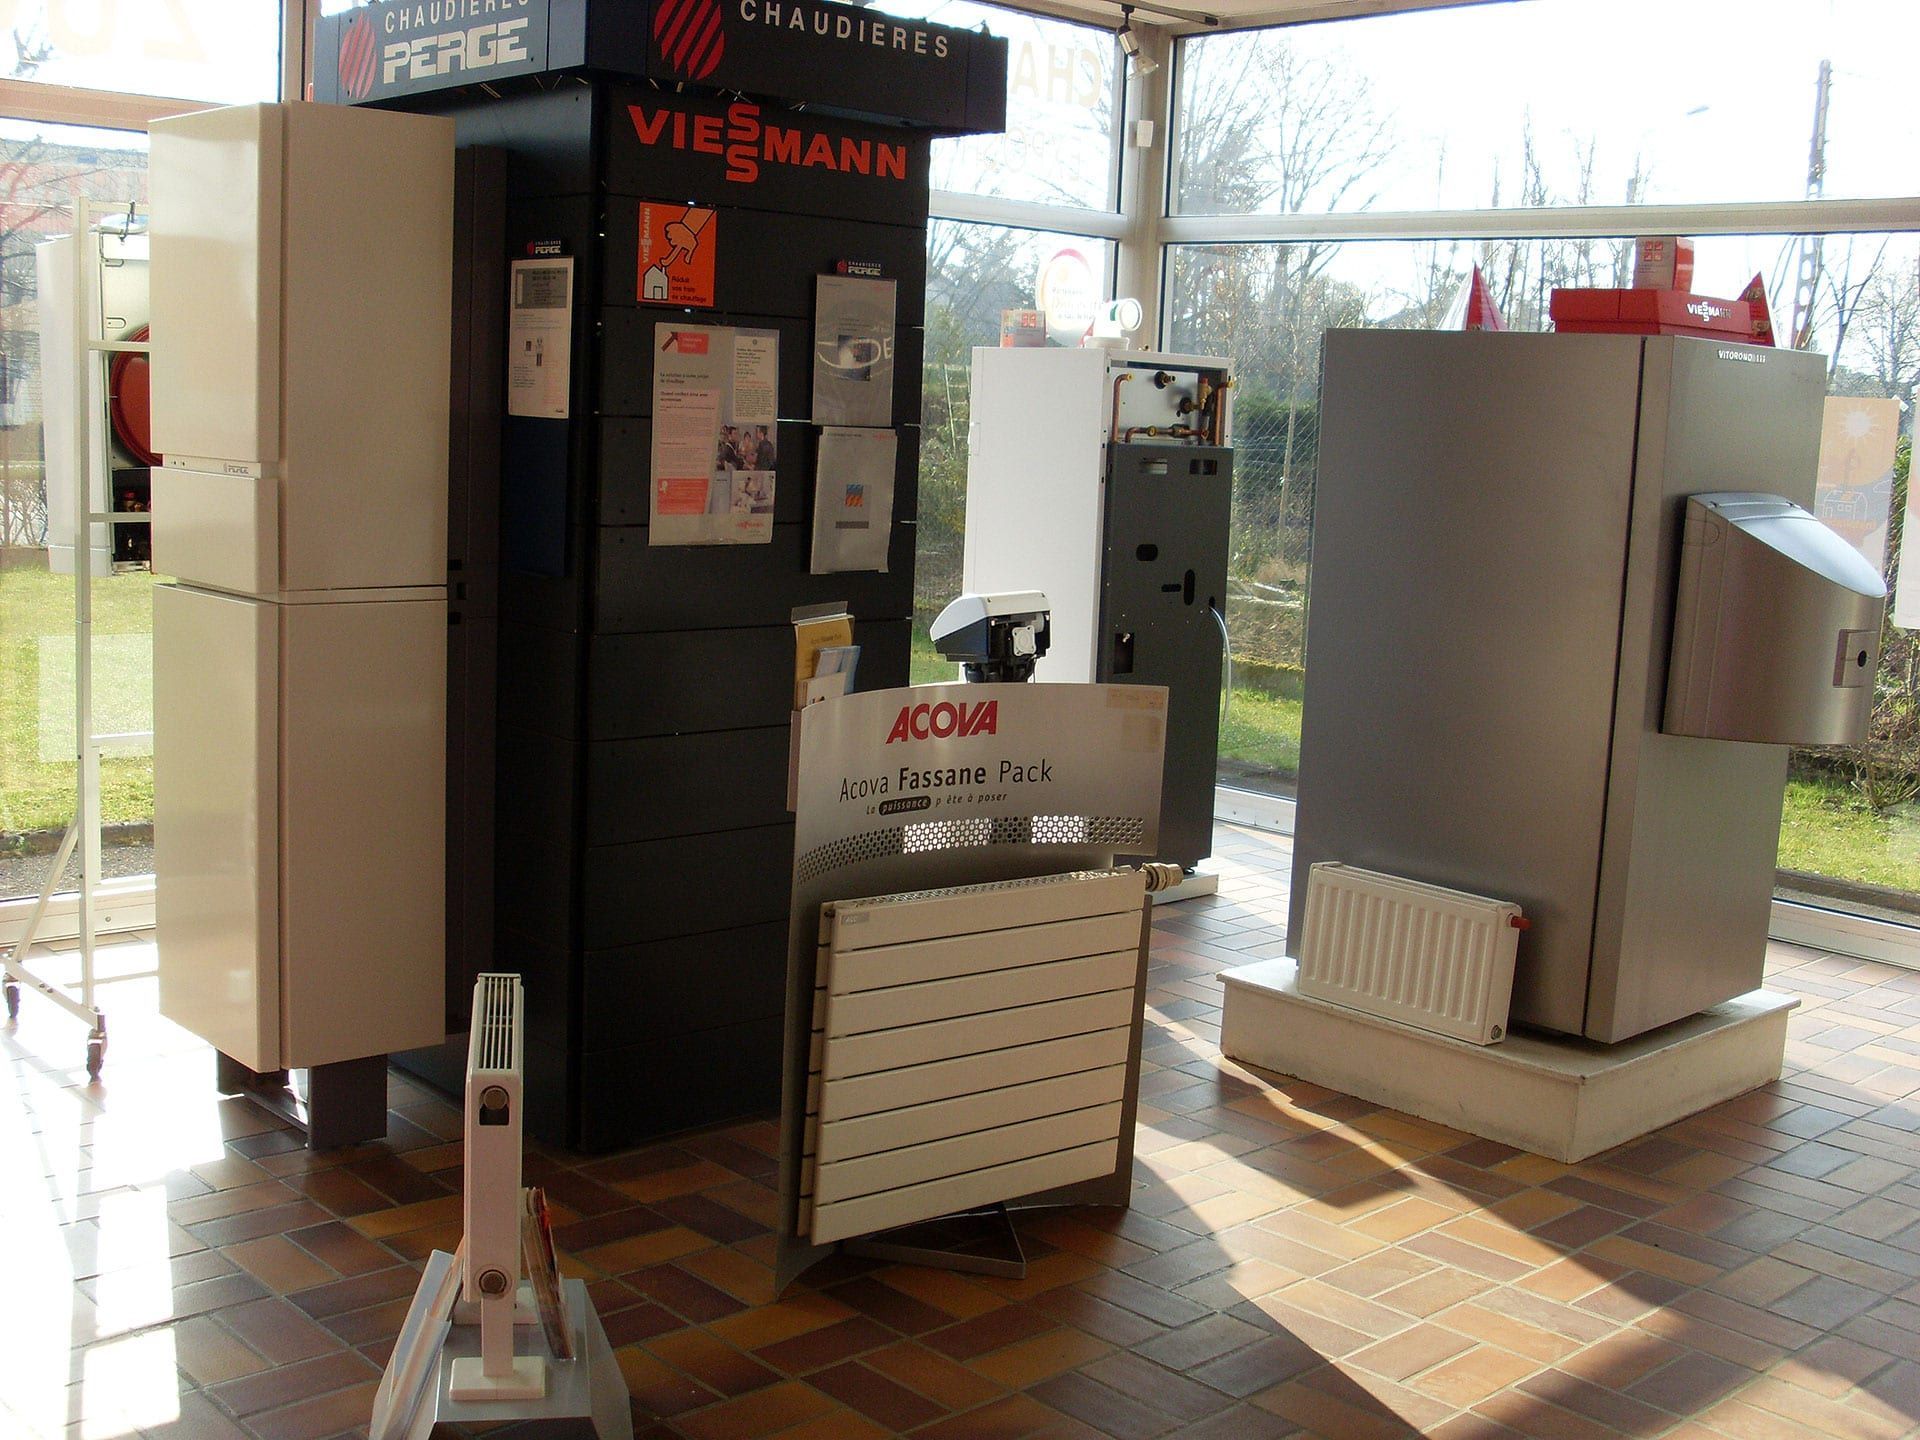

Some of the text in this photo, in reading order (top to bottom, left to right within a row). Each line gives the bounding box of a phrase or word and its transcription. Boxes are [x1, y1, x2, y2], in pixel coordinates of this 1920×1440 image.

[385, 0, 528, 34] CHAUDIER
[740, 0, 948, 58] CHAUDIERES
[383, 17, 528, 84] PERGE
[627, 104, 907, 183] VIESSMANN
[886, 700, 998, 744] ACOVA
[839, 758, 1053, 802] Acova Fassane Pack
[882, 799, 928, 815] puissance
[977, 793, 1008, 805] poser
